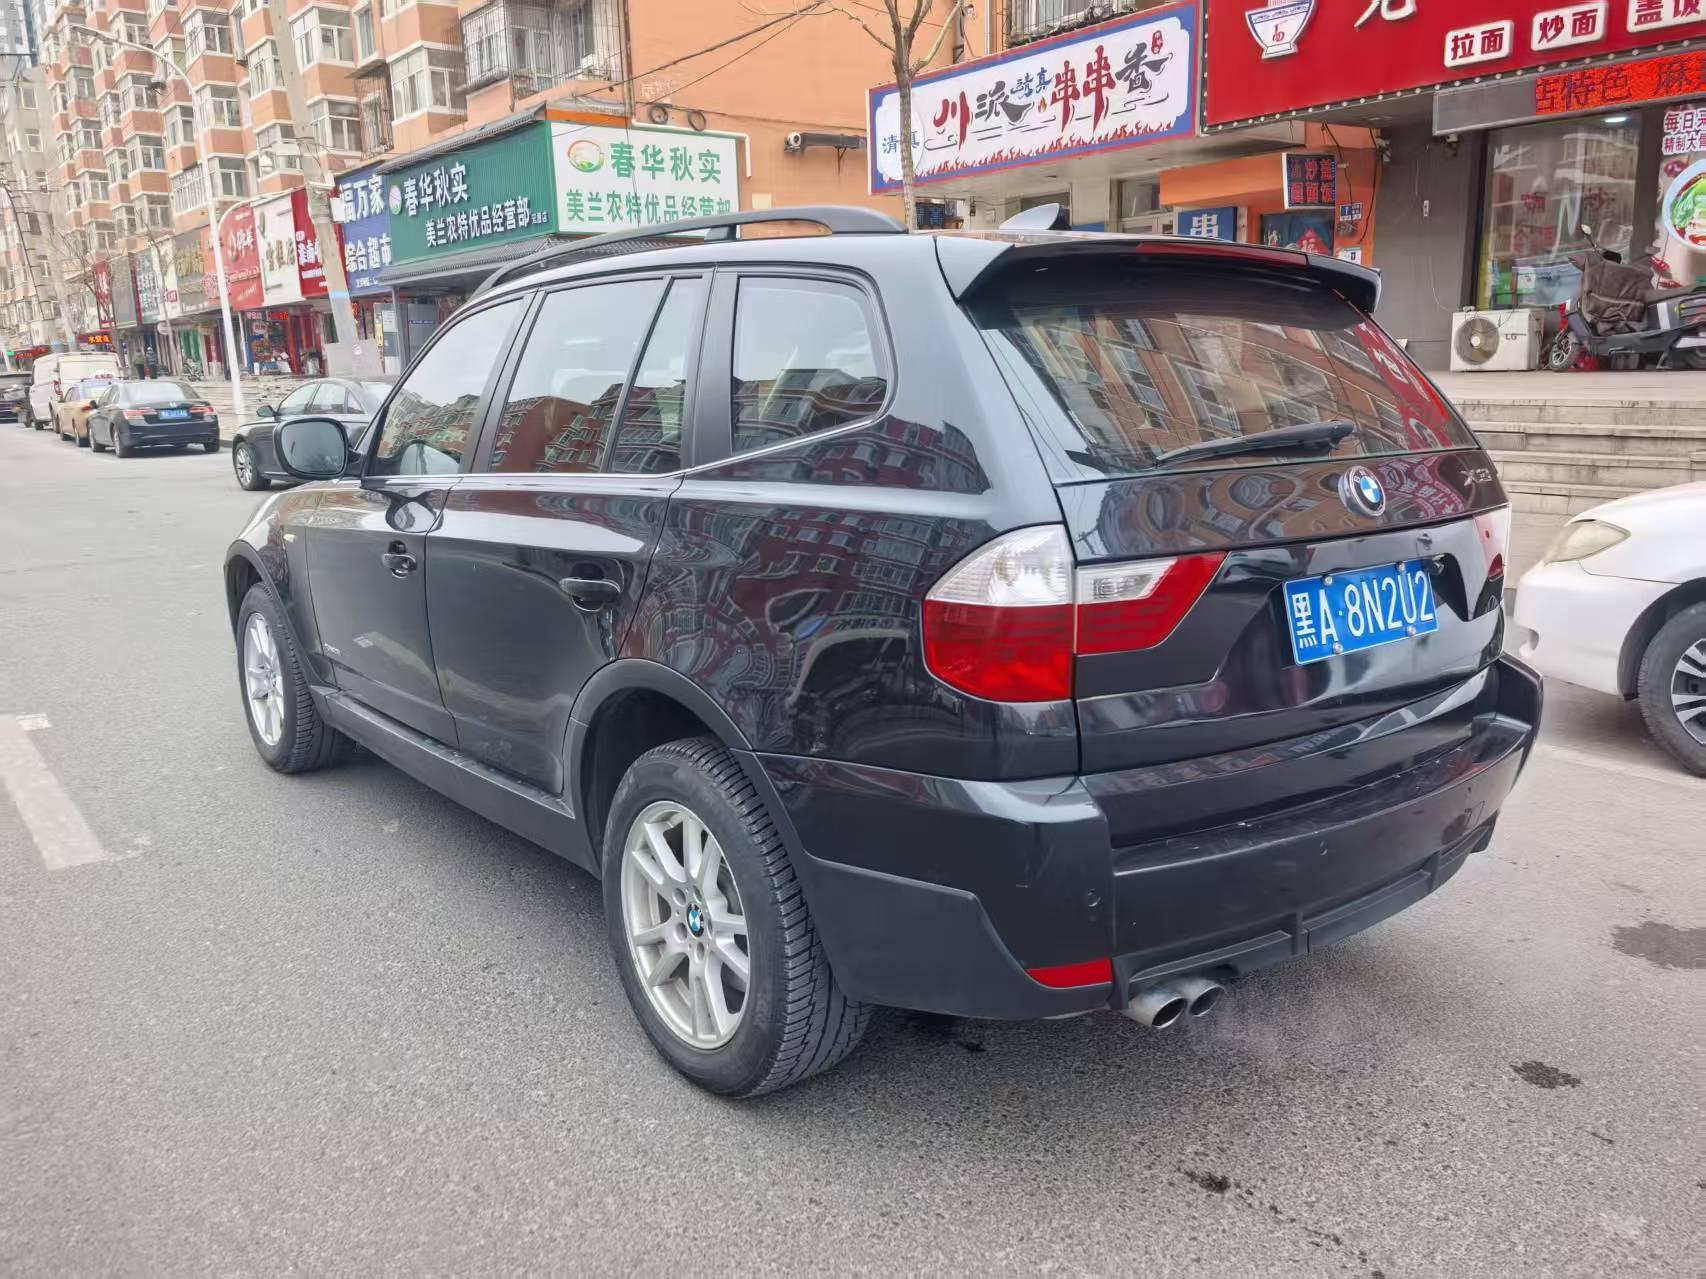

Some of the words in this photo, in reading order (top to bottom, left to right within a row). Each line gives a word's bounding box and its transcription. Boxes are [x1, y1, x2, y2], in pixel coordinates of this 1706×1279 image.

[1451, 26, 1505, 60] 拉面
[1538, 8, 1598, 44] 炒面
[1050, 43, 1173, 133] 串串香
[610, 141, 721, 184] 春华秋实
[403, 162, 468, 216] 春华秋实
[566, 188, 731, 224] 美兰农特优品经营部
[425, 196, 530, 247] 美兰农特优品经营部
[345, 232, 392, 273] 综合超市
